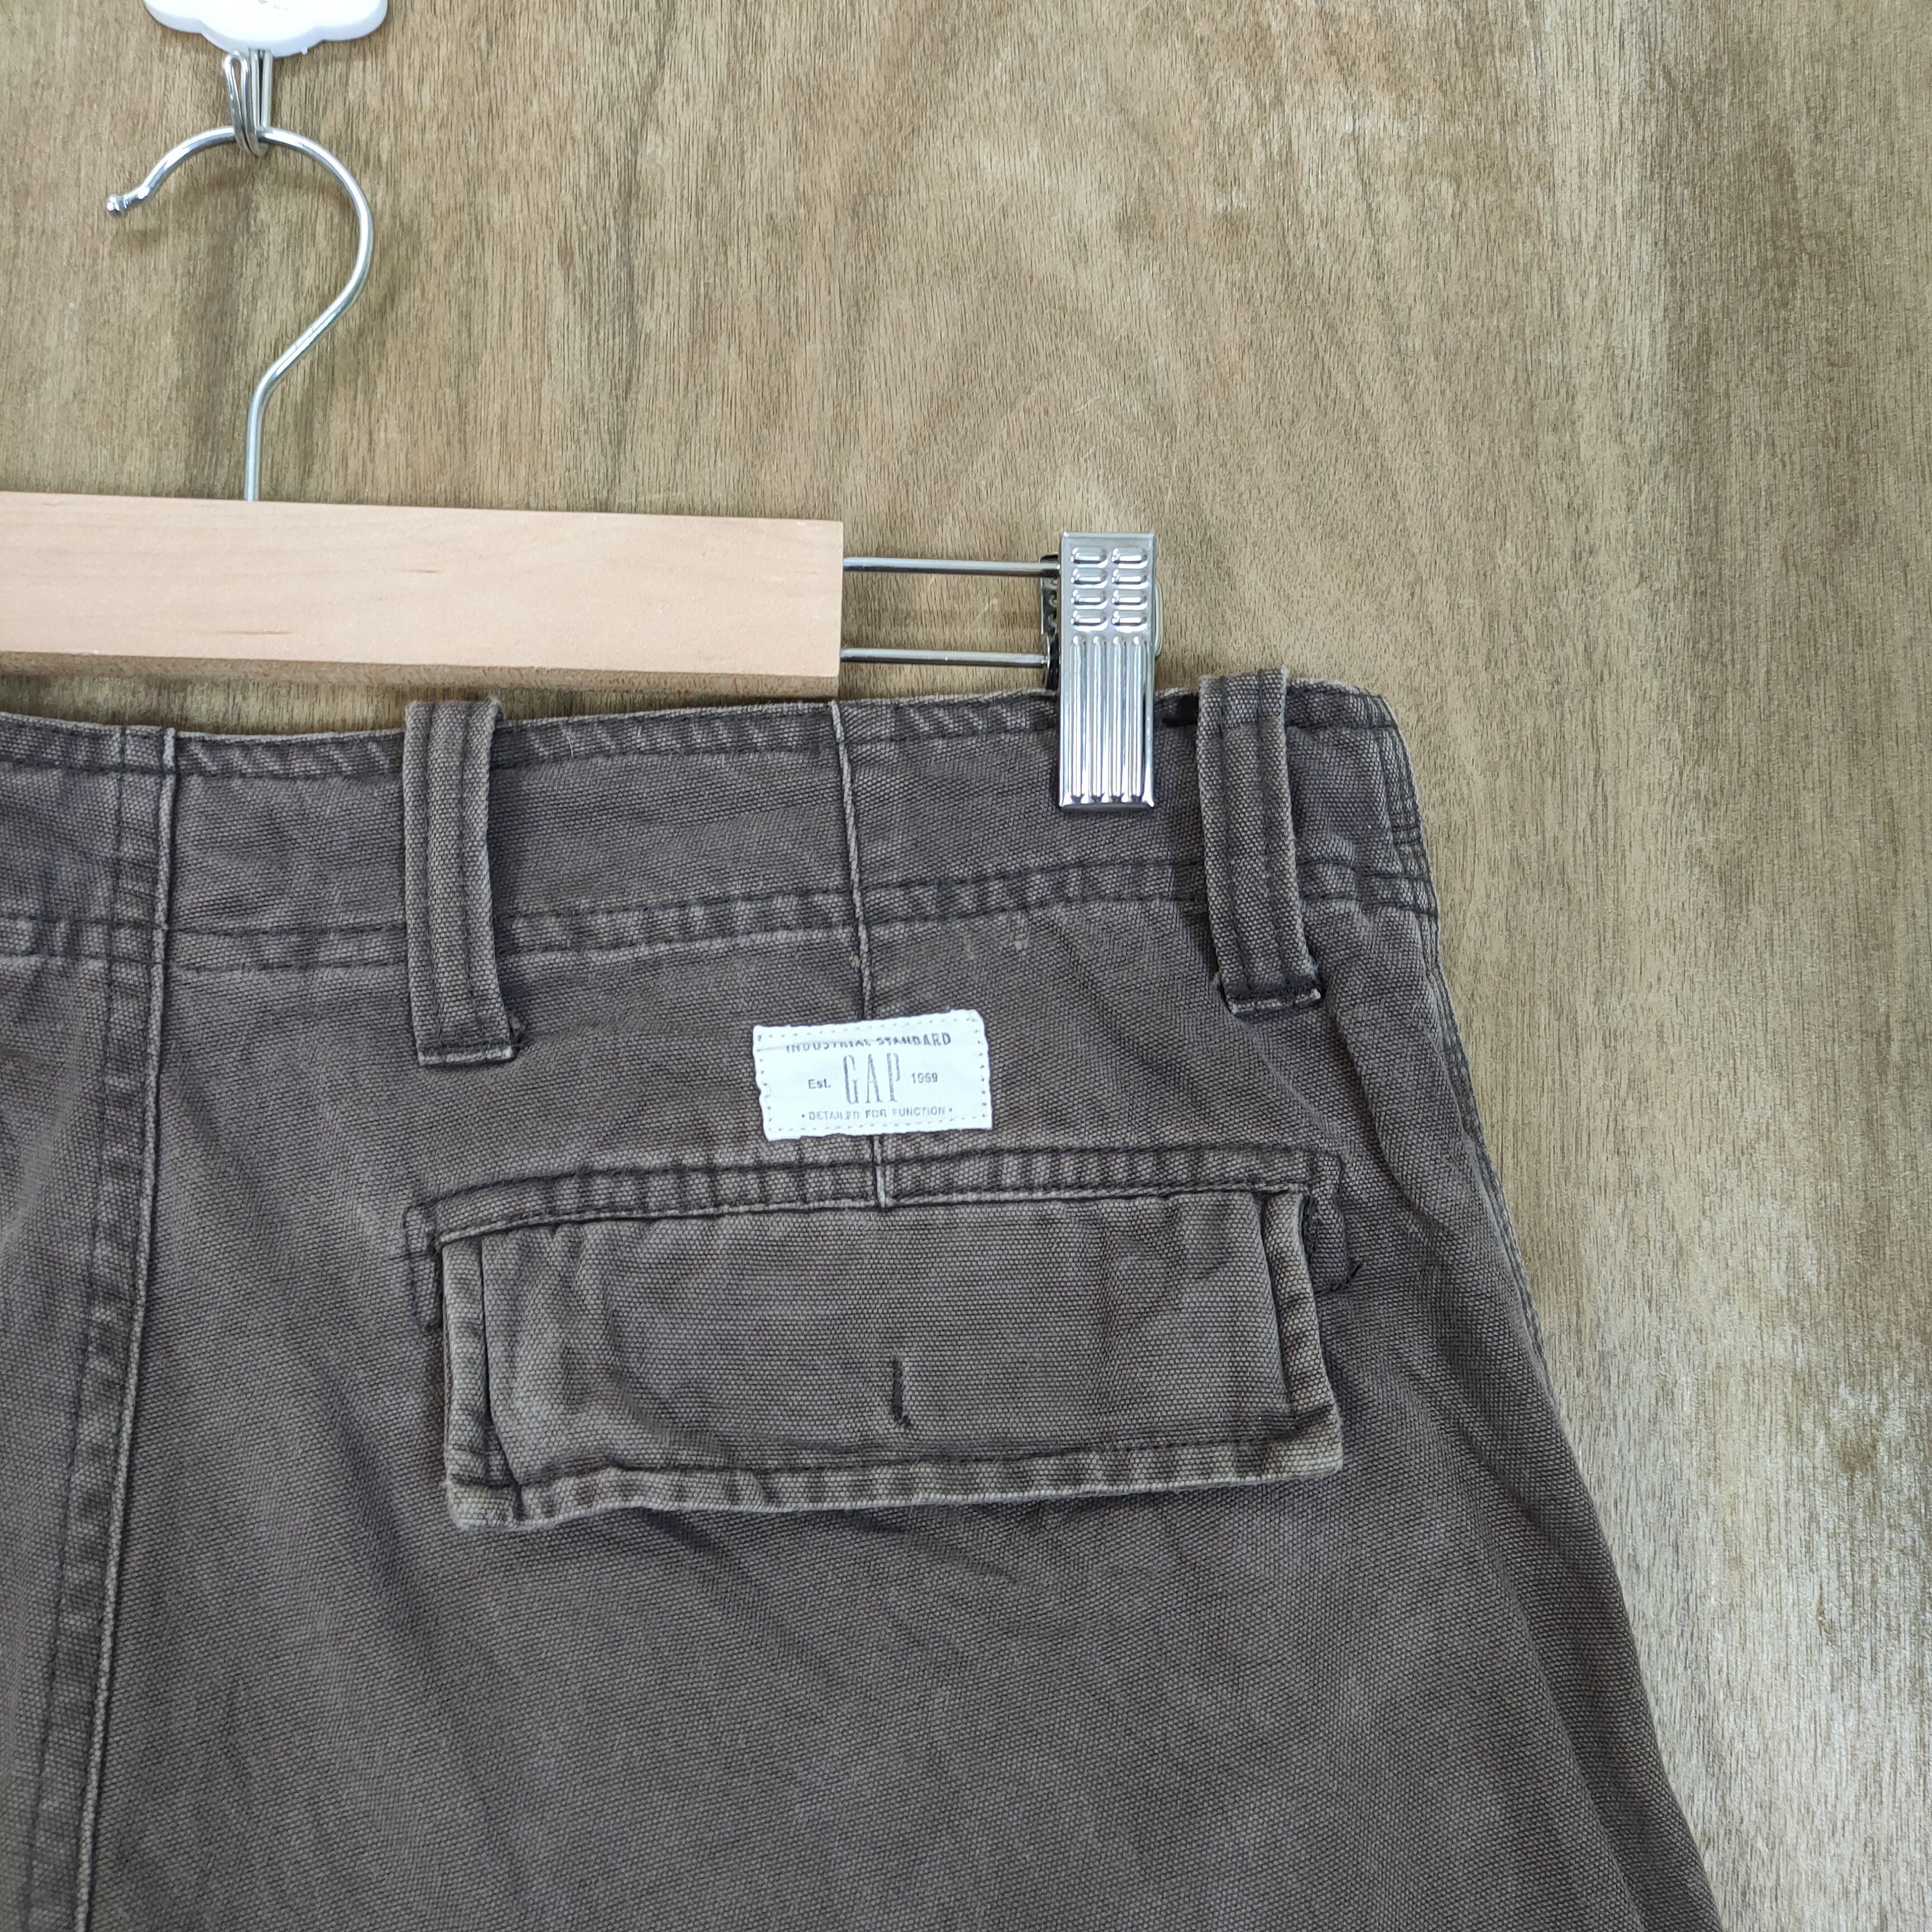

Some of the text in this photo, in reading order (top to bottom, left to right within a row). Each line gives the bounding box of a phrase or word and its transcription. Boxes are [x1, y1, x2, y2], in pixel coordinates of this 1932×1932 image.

[876, 1033, 951, 1046] STANDARD
[808, 1053, 937, 1104] Est. GAP 1969
[809, 1106, 945, 1120] DETAILED FOR FUNCTION
